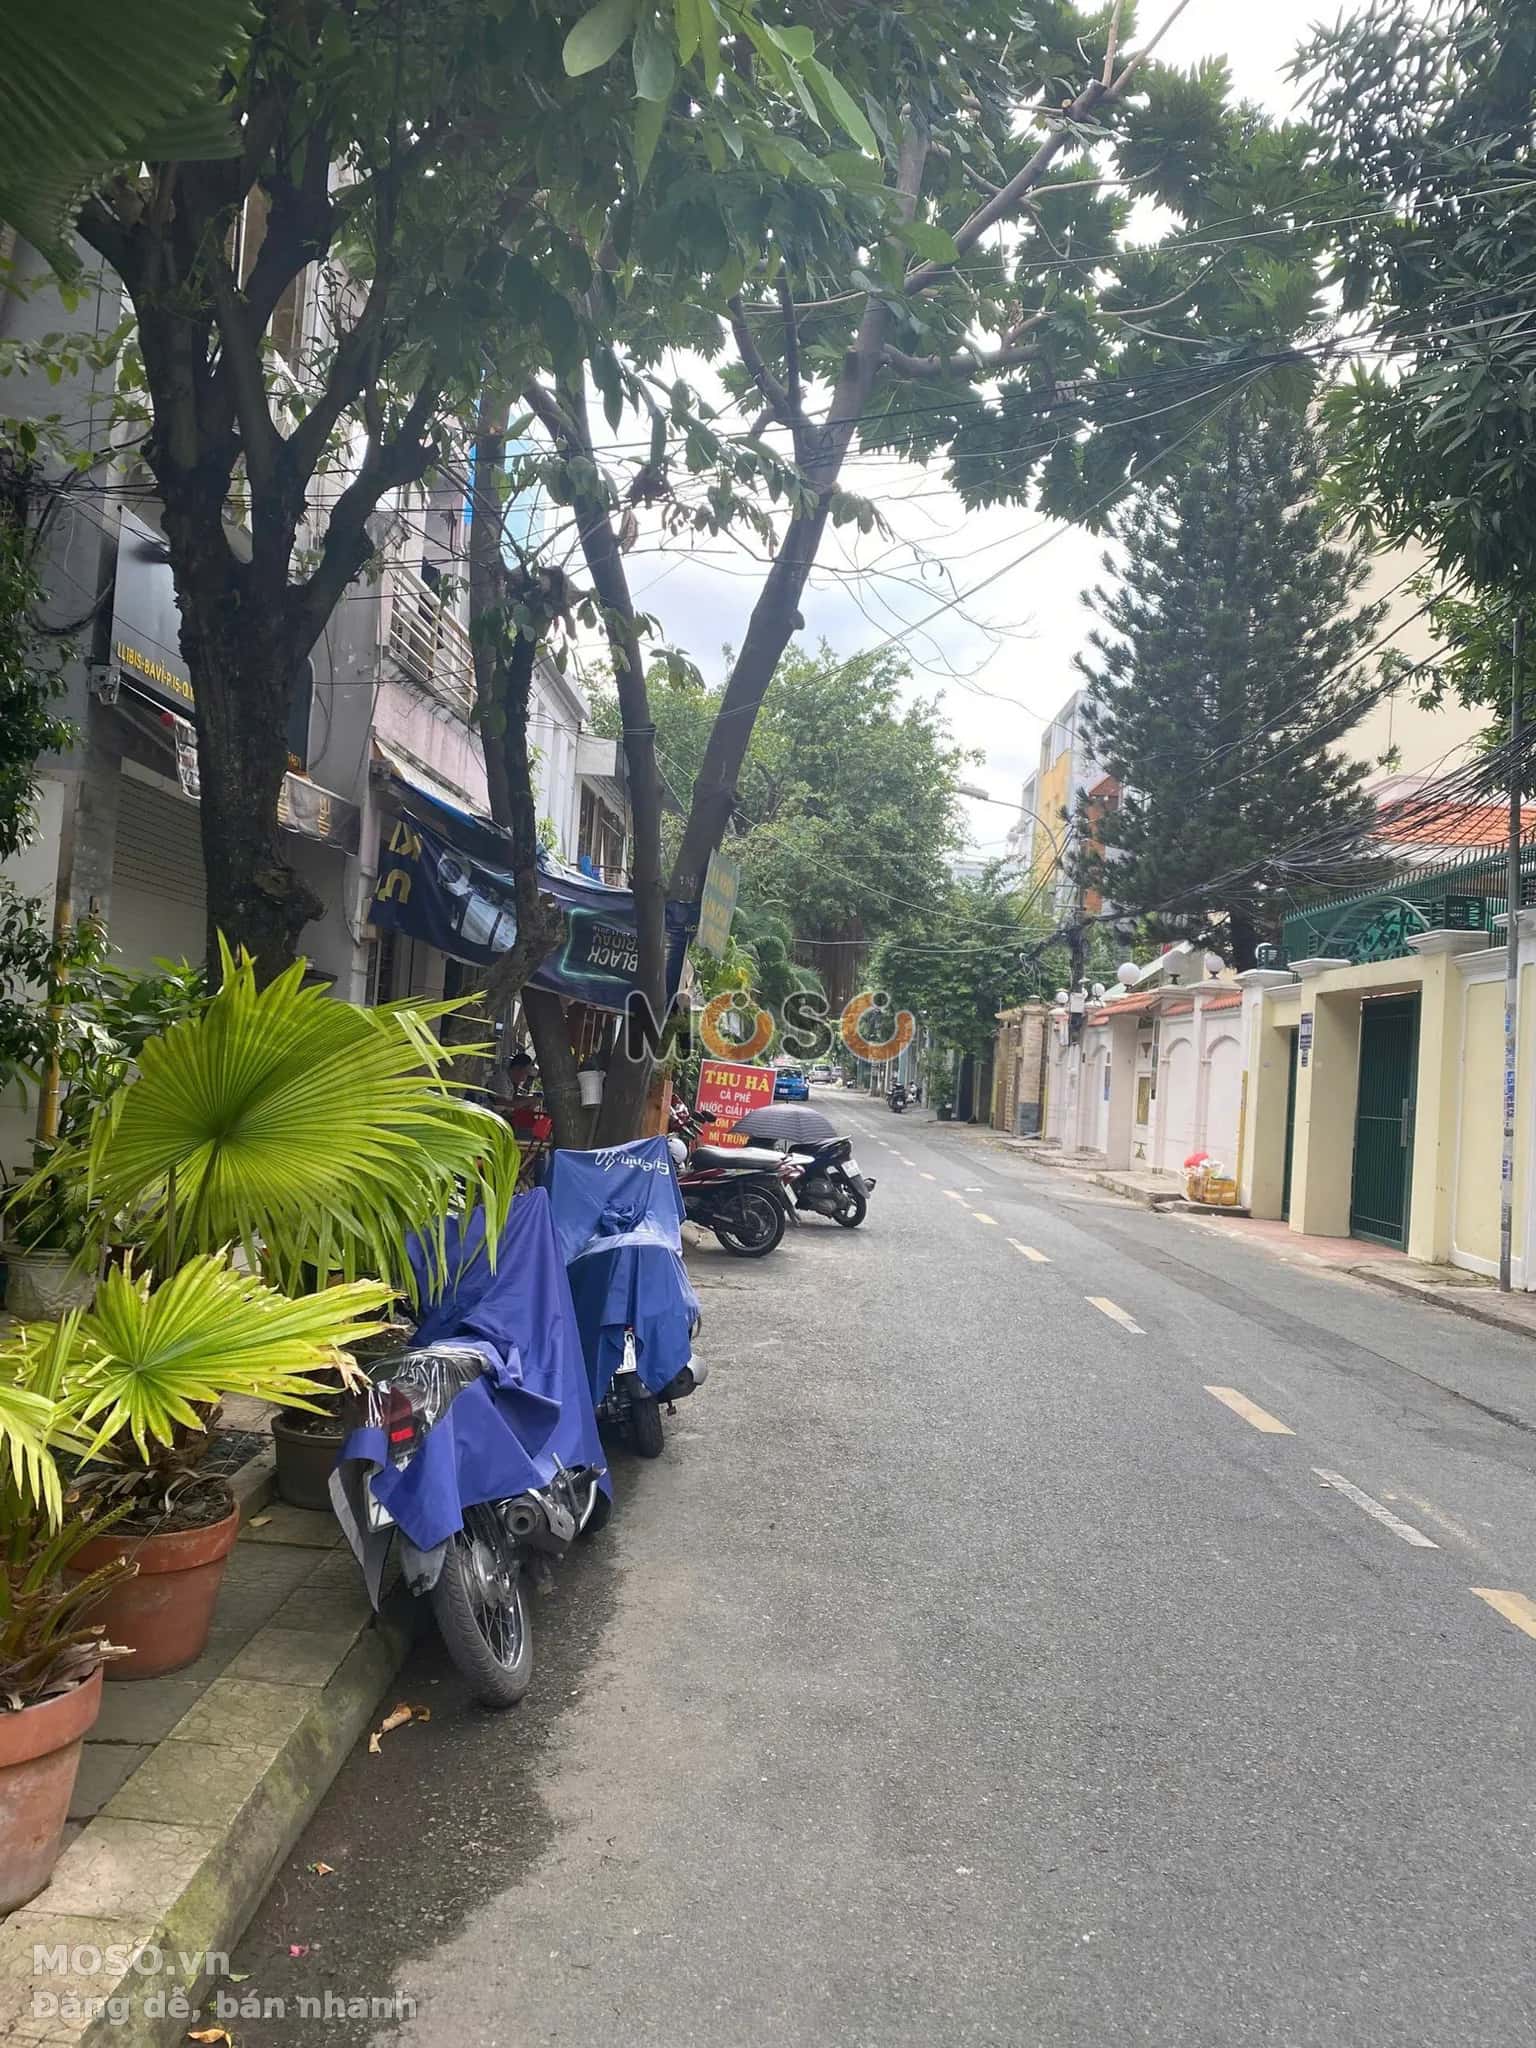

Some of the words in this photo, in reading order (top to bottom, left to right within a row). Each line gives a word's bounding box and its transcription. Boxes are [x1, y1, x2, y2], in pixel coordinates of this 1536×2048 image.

[587, 945, 639, 972] BLACK
[704, 1070, 741, 1087] THU
[744, 1073, 770, 1093] HÀ
[719, 1088, 731, 1100] CÀ
[734, 1091, 752, 1104] PHÊ
